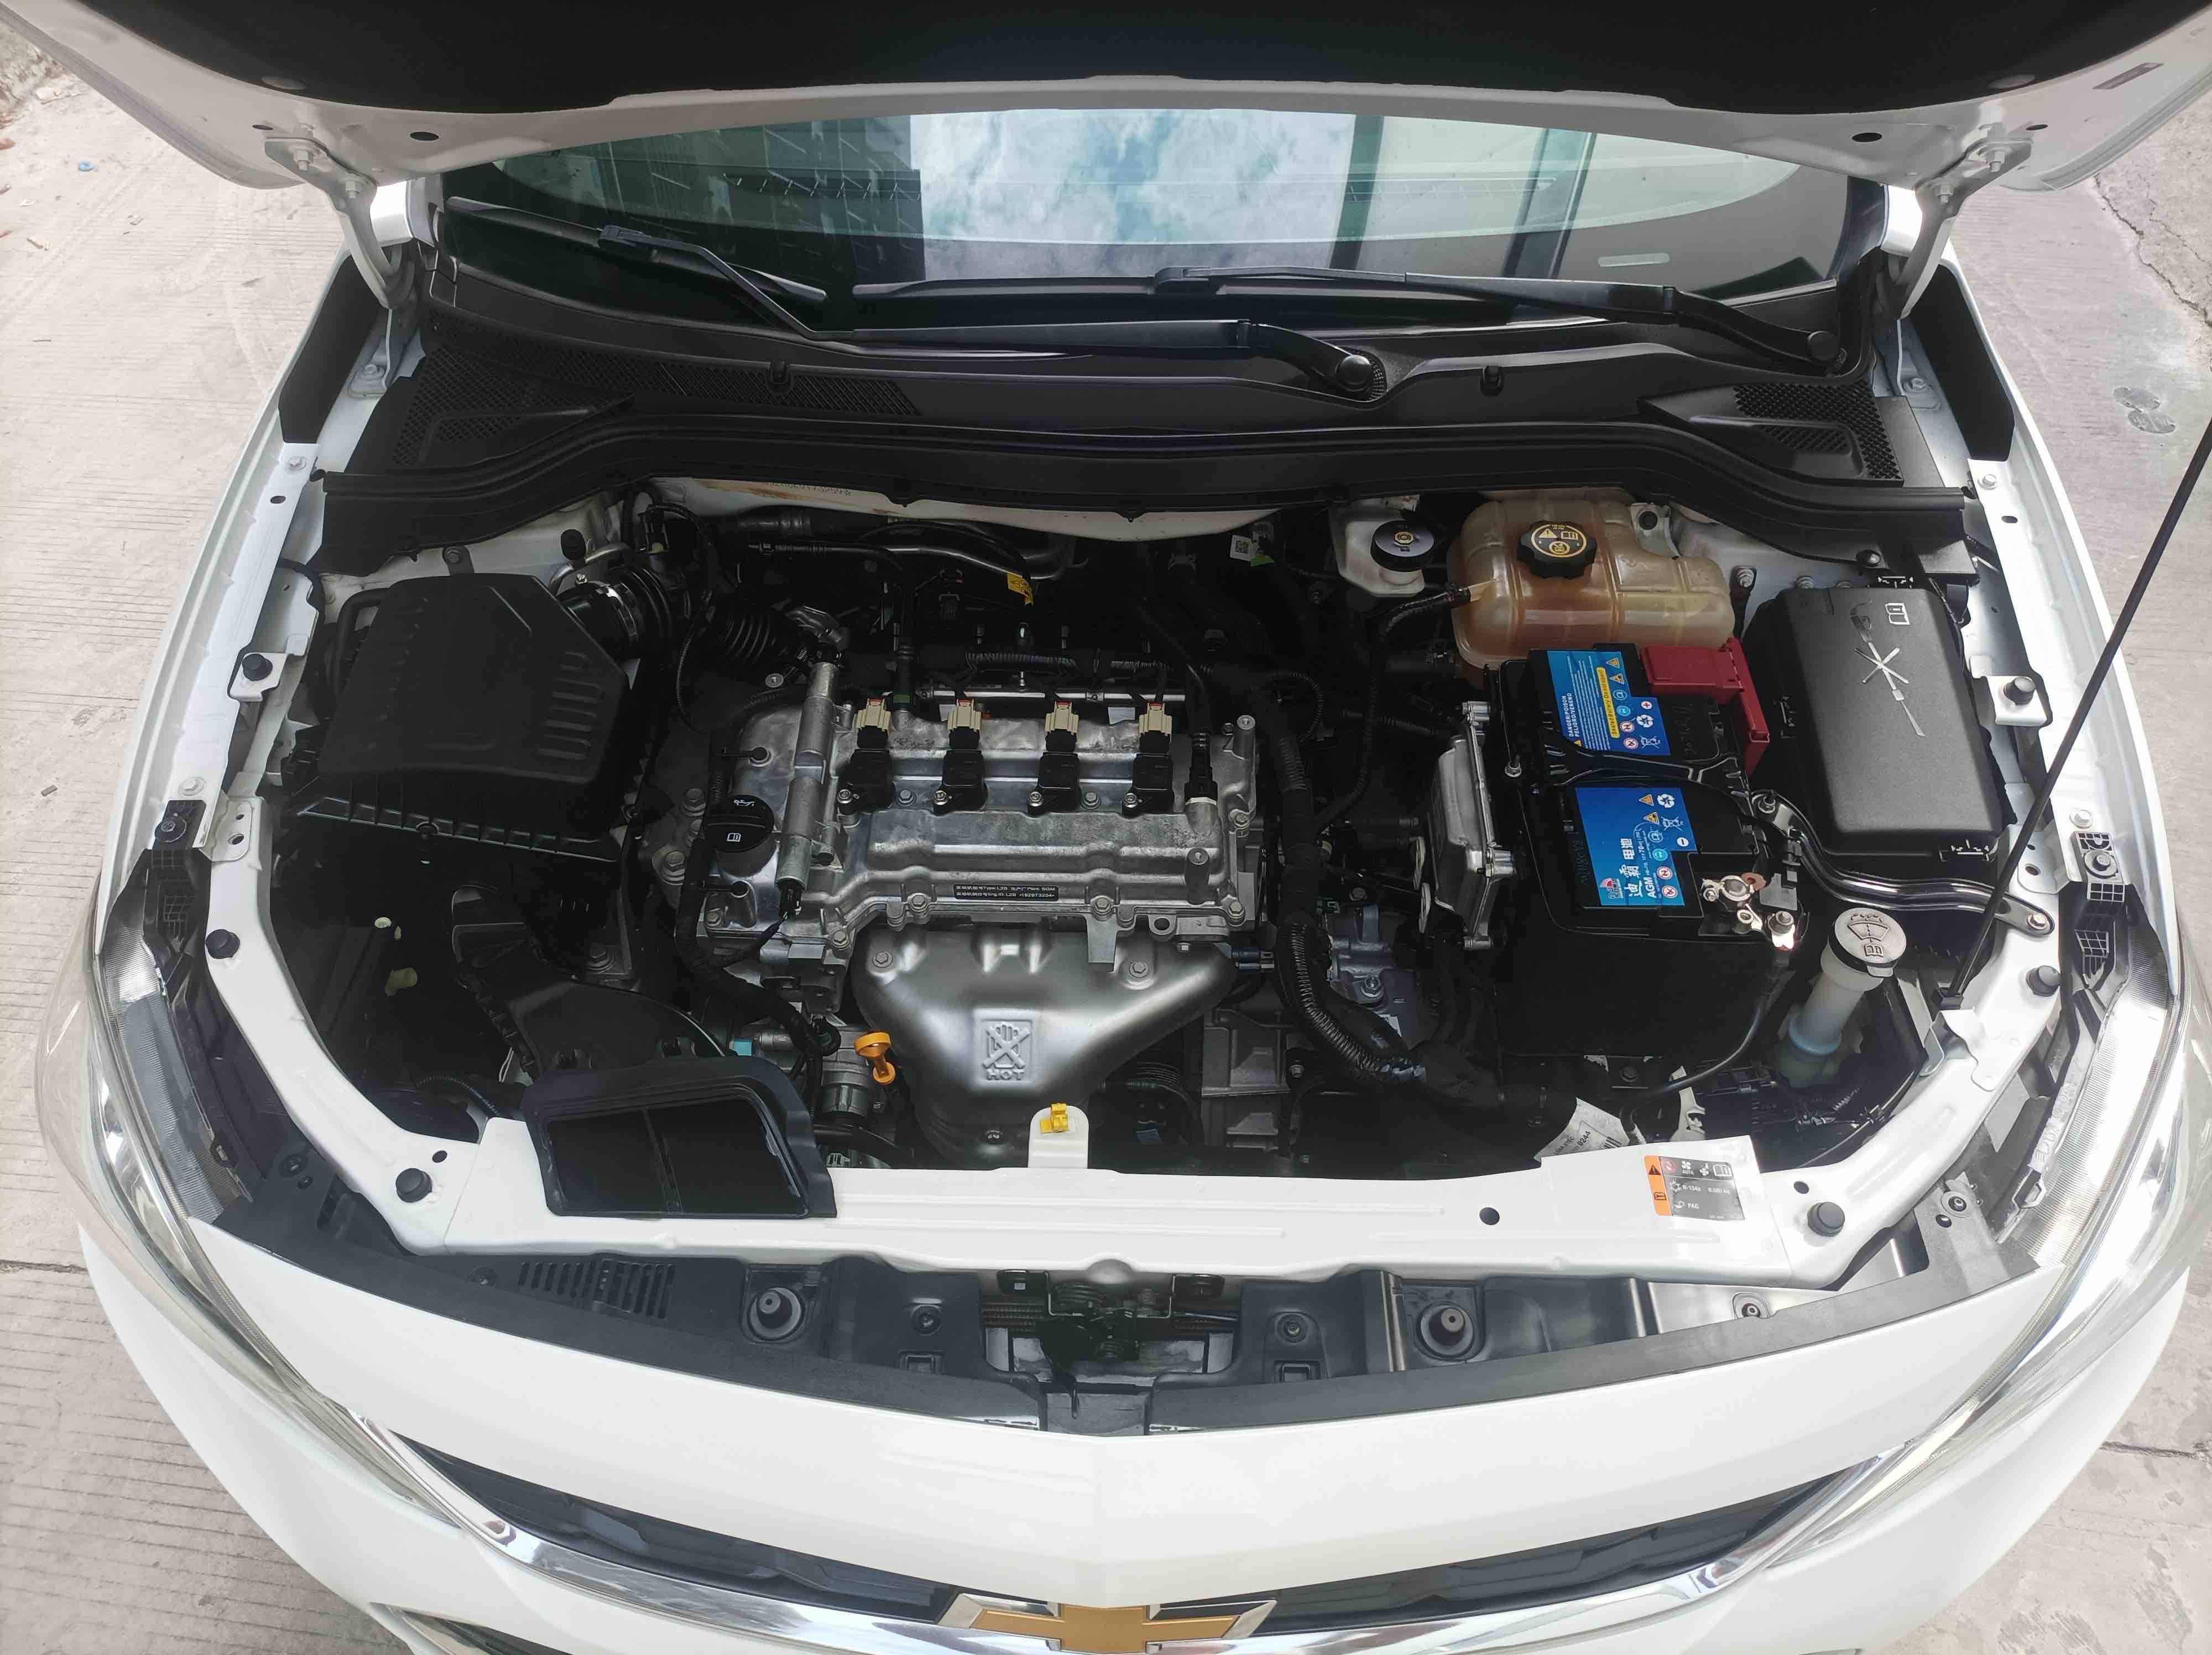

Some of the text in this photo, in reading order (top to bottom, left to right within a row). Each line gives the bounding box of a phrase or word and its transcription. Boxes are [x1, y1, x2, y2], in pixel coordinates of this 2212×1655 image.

[1562, 695, 1574, 737] DANGER/POISON
[1620, 838, 1635, 860] 电池
[1643, 877, 1657, 899] AGM
[985, 1068, 1025, 1081] HOT
